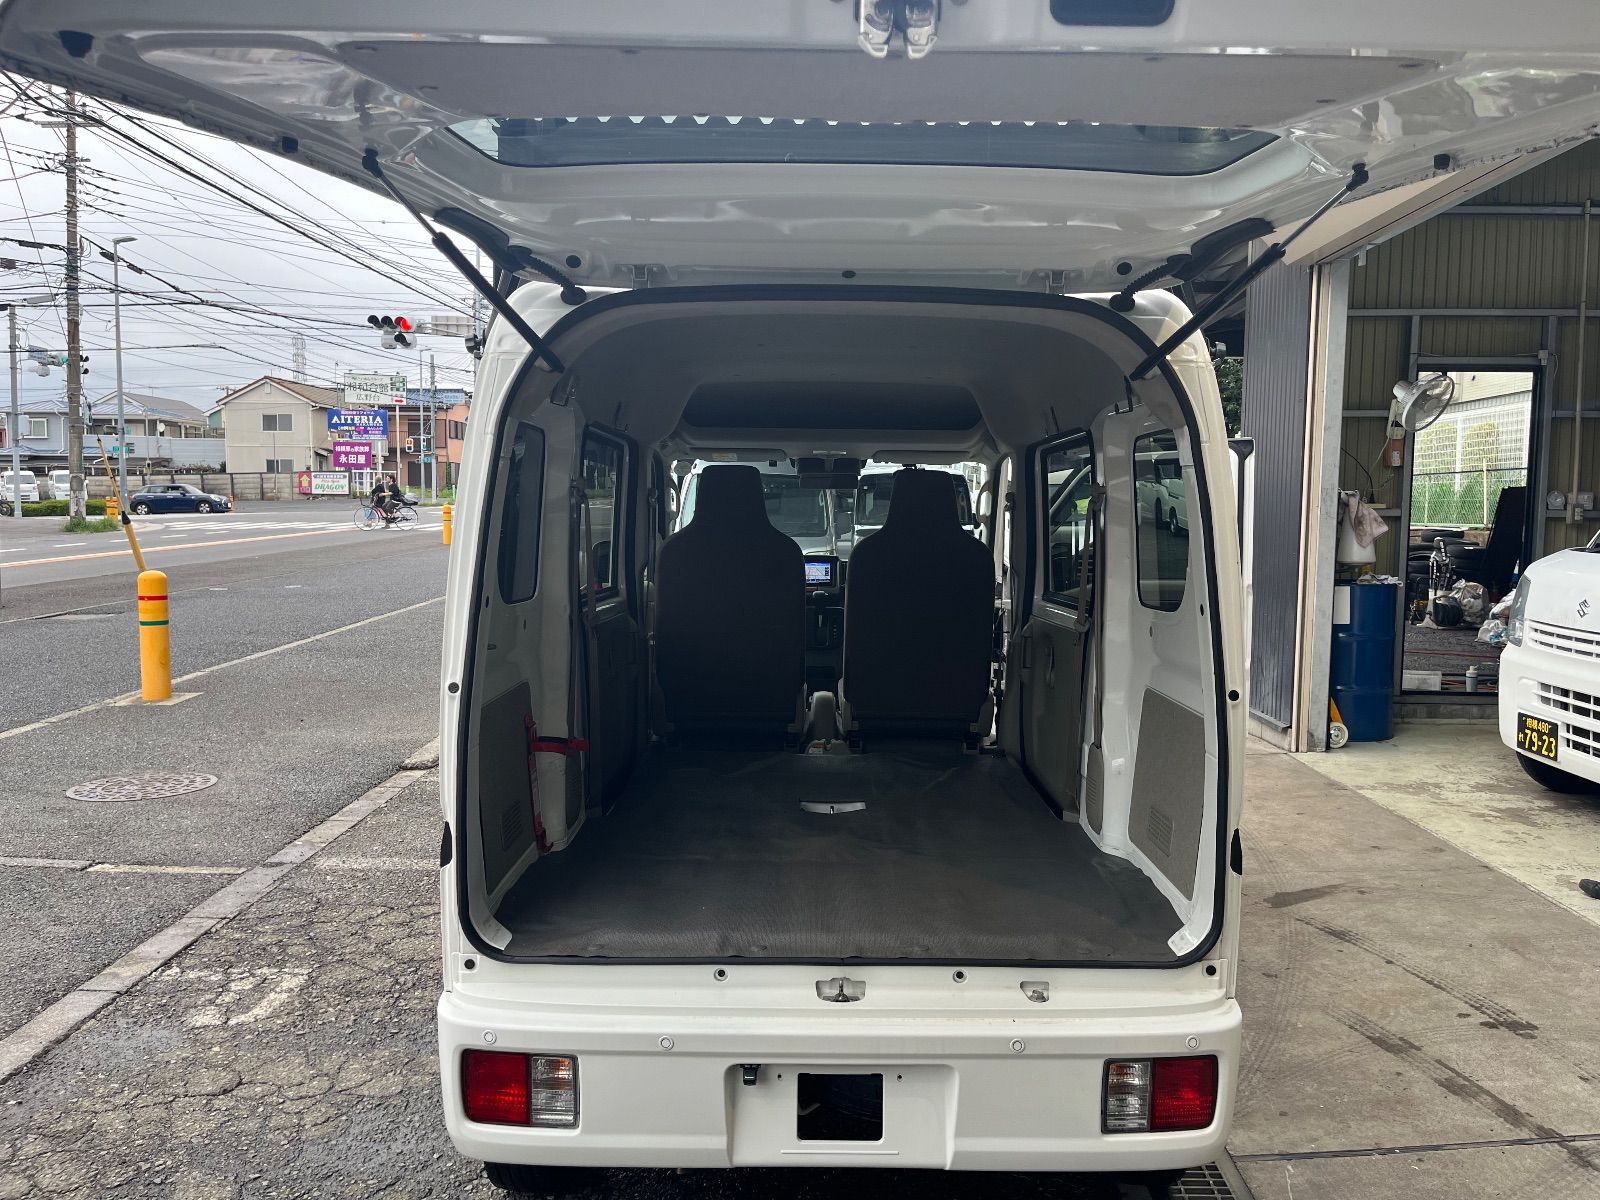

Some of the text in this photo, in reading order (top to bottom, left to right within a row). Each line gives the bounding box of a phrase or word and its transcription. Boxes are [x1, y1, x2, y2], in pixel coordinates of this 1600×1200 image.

[331, 415, 383, 424] AITERIA
[339, 454, 366, 464] 永田屋
[1525, 729, 1556, 757] 79-23
